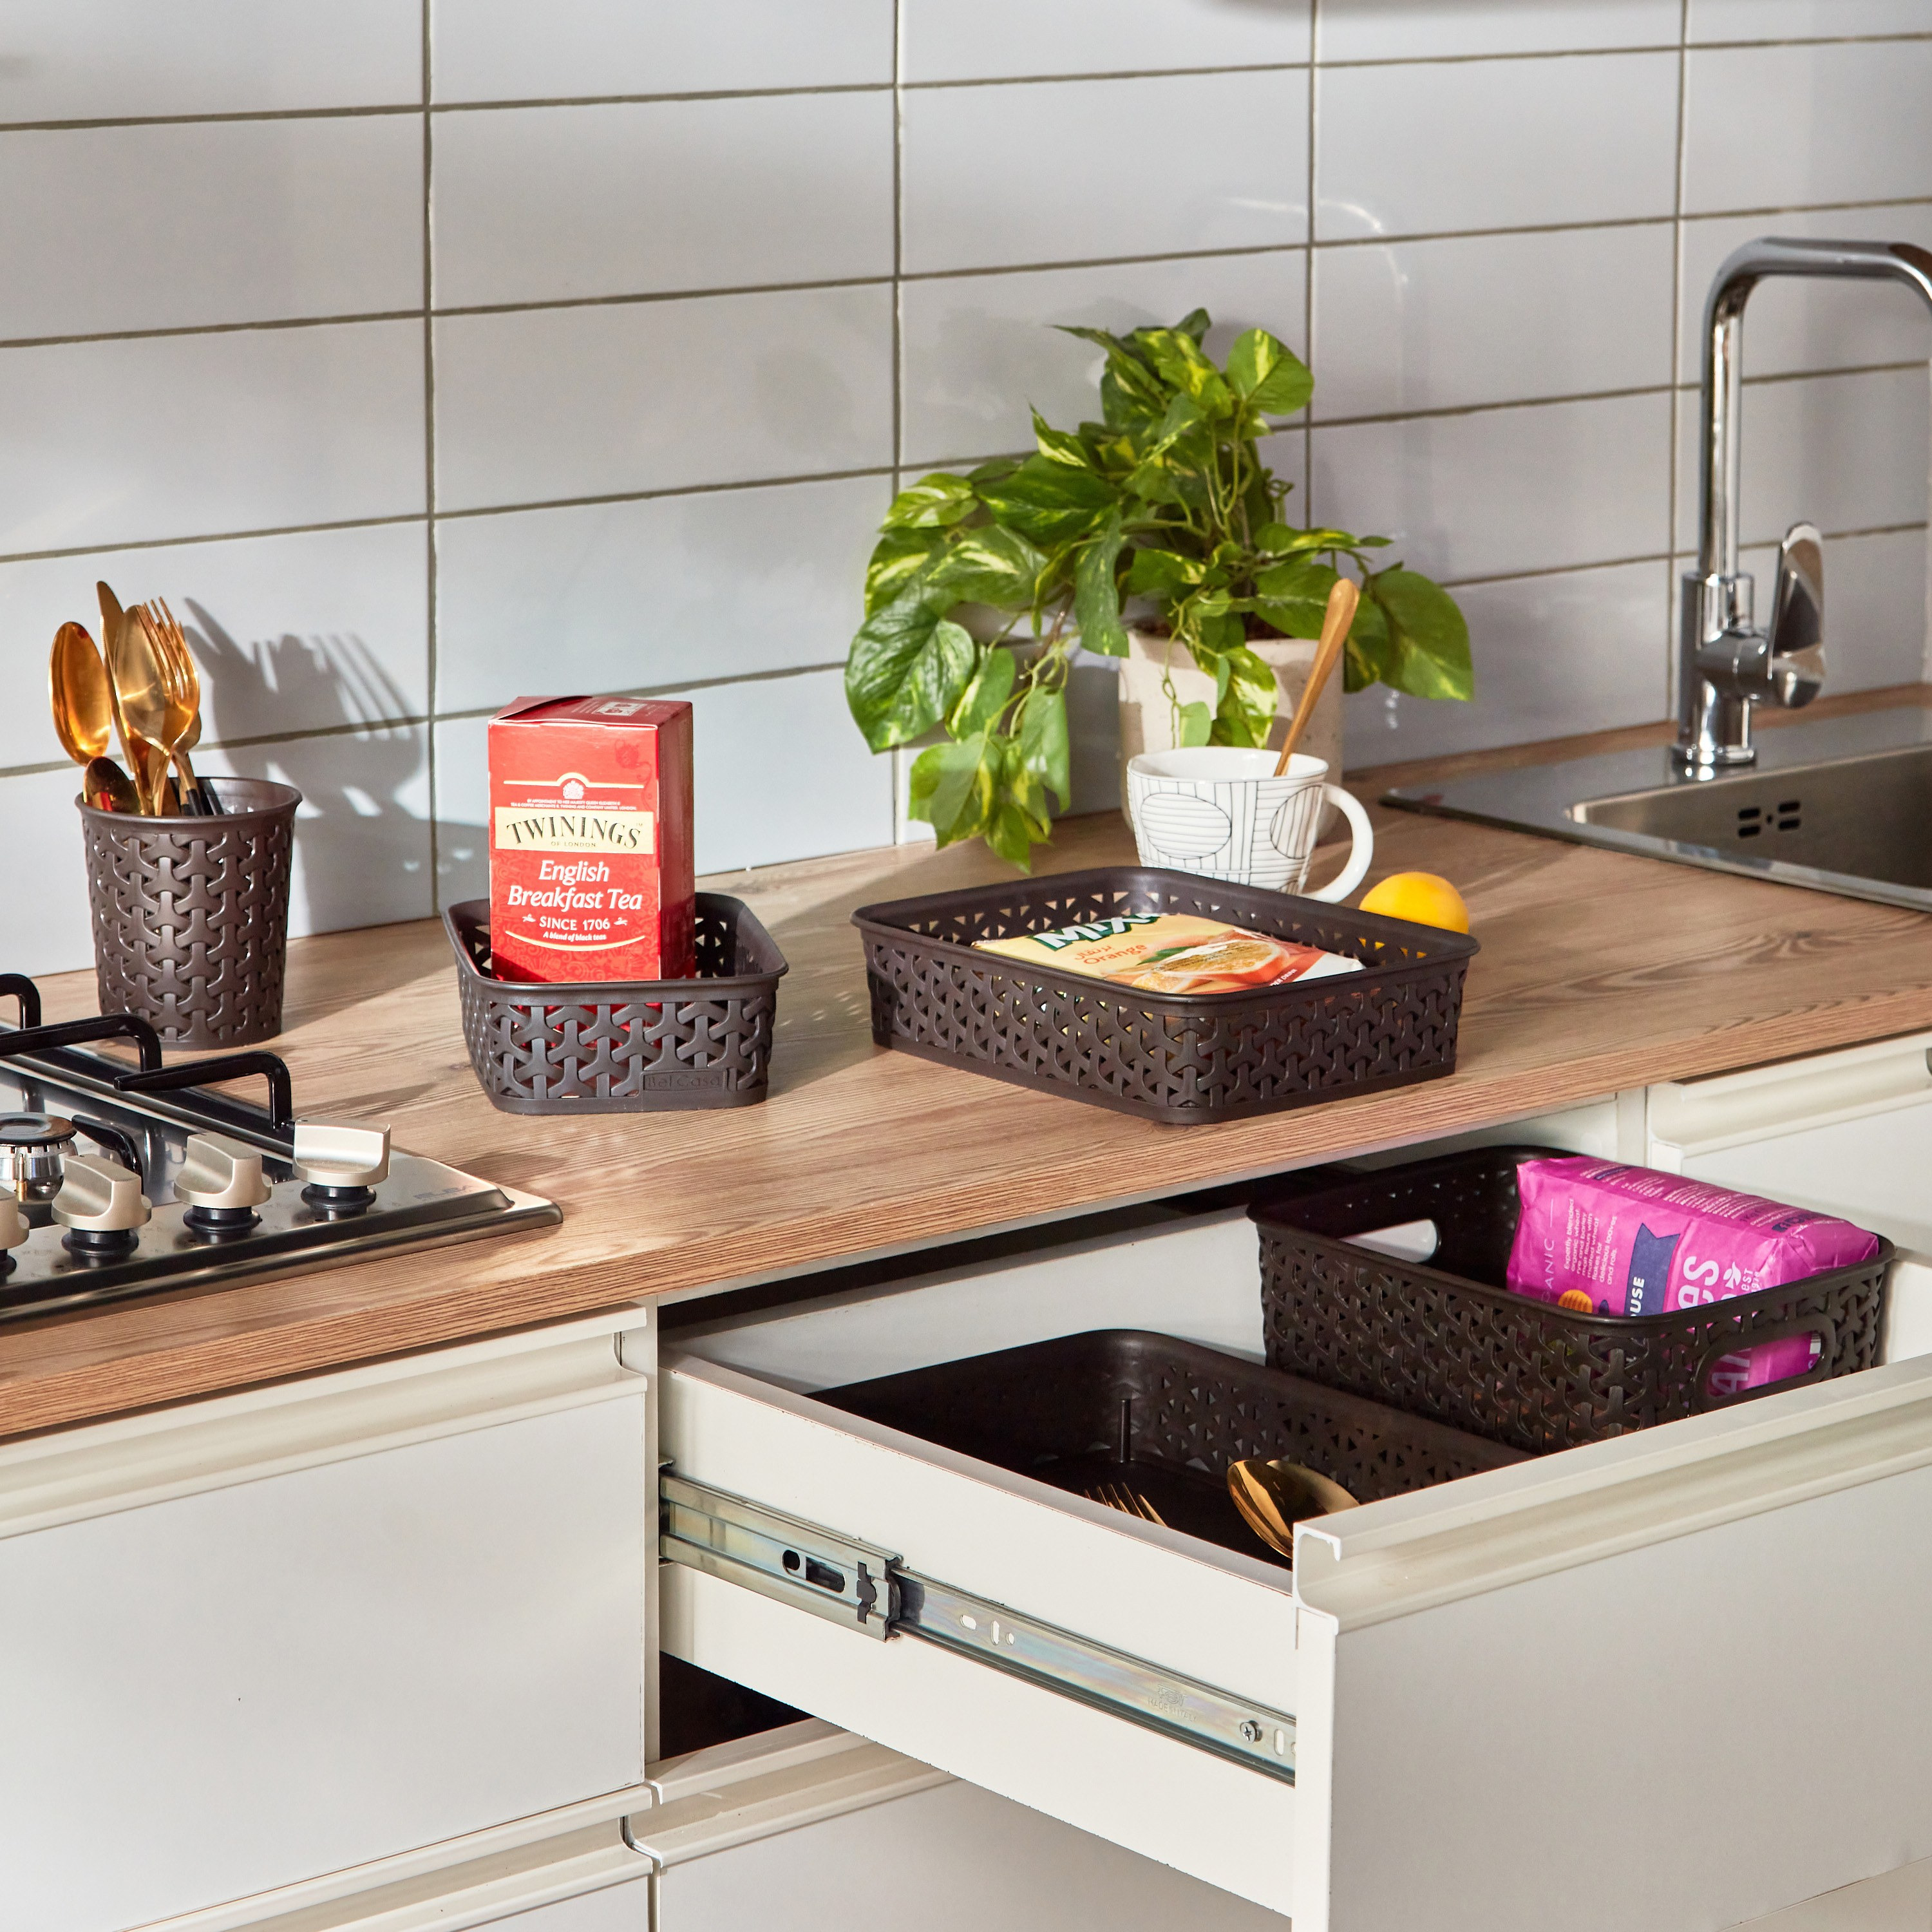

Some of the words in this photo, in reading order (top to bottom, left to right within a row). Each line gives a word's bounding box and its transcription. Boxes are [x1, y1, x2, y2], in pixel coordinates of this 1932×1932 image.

[506, 816, 641, 849] TWININGS
[538, 860, 610, 886] English
[507, 885, 604, 912] Breakfast
[607, 888, 643, 910] Tea
[539, 916, 577, 931] SINCE
[582, 918, 611, 931] 1706
[549, 931, 567, 940] blend
[567, 933, 575, 942] of
[1034, 913, 1160, 949] MIX
[1083, 945, 1147, 964] Orange
[1566, 1198, 1574, 1235] blended
[1564, 1236, 1573, 1270] Expertly
[1599, 1245, 1610, 1283] delicious
[1605, 1216, 1617, 1244] loaves
[1592, 1255, 1600, 1280] flakes
[1629, 1276, 1645, 1316] USE
